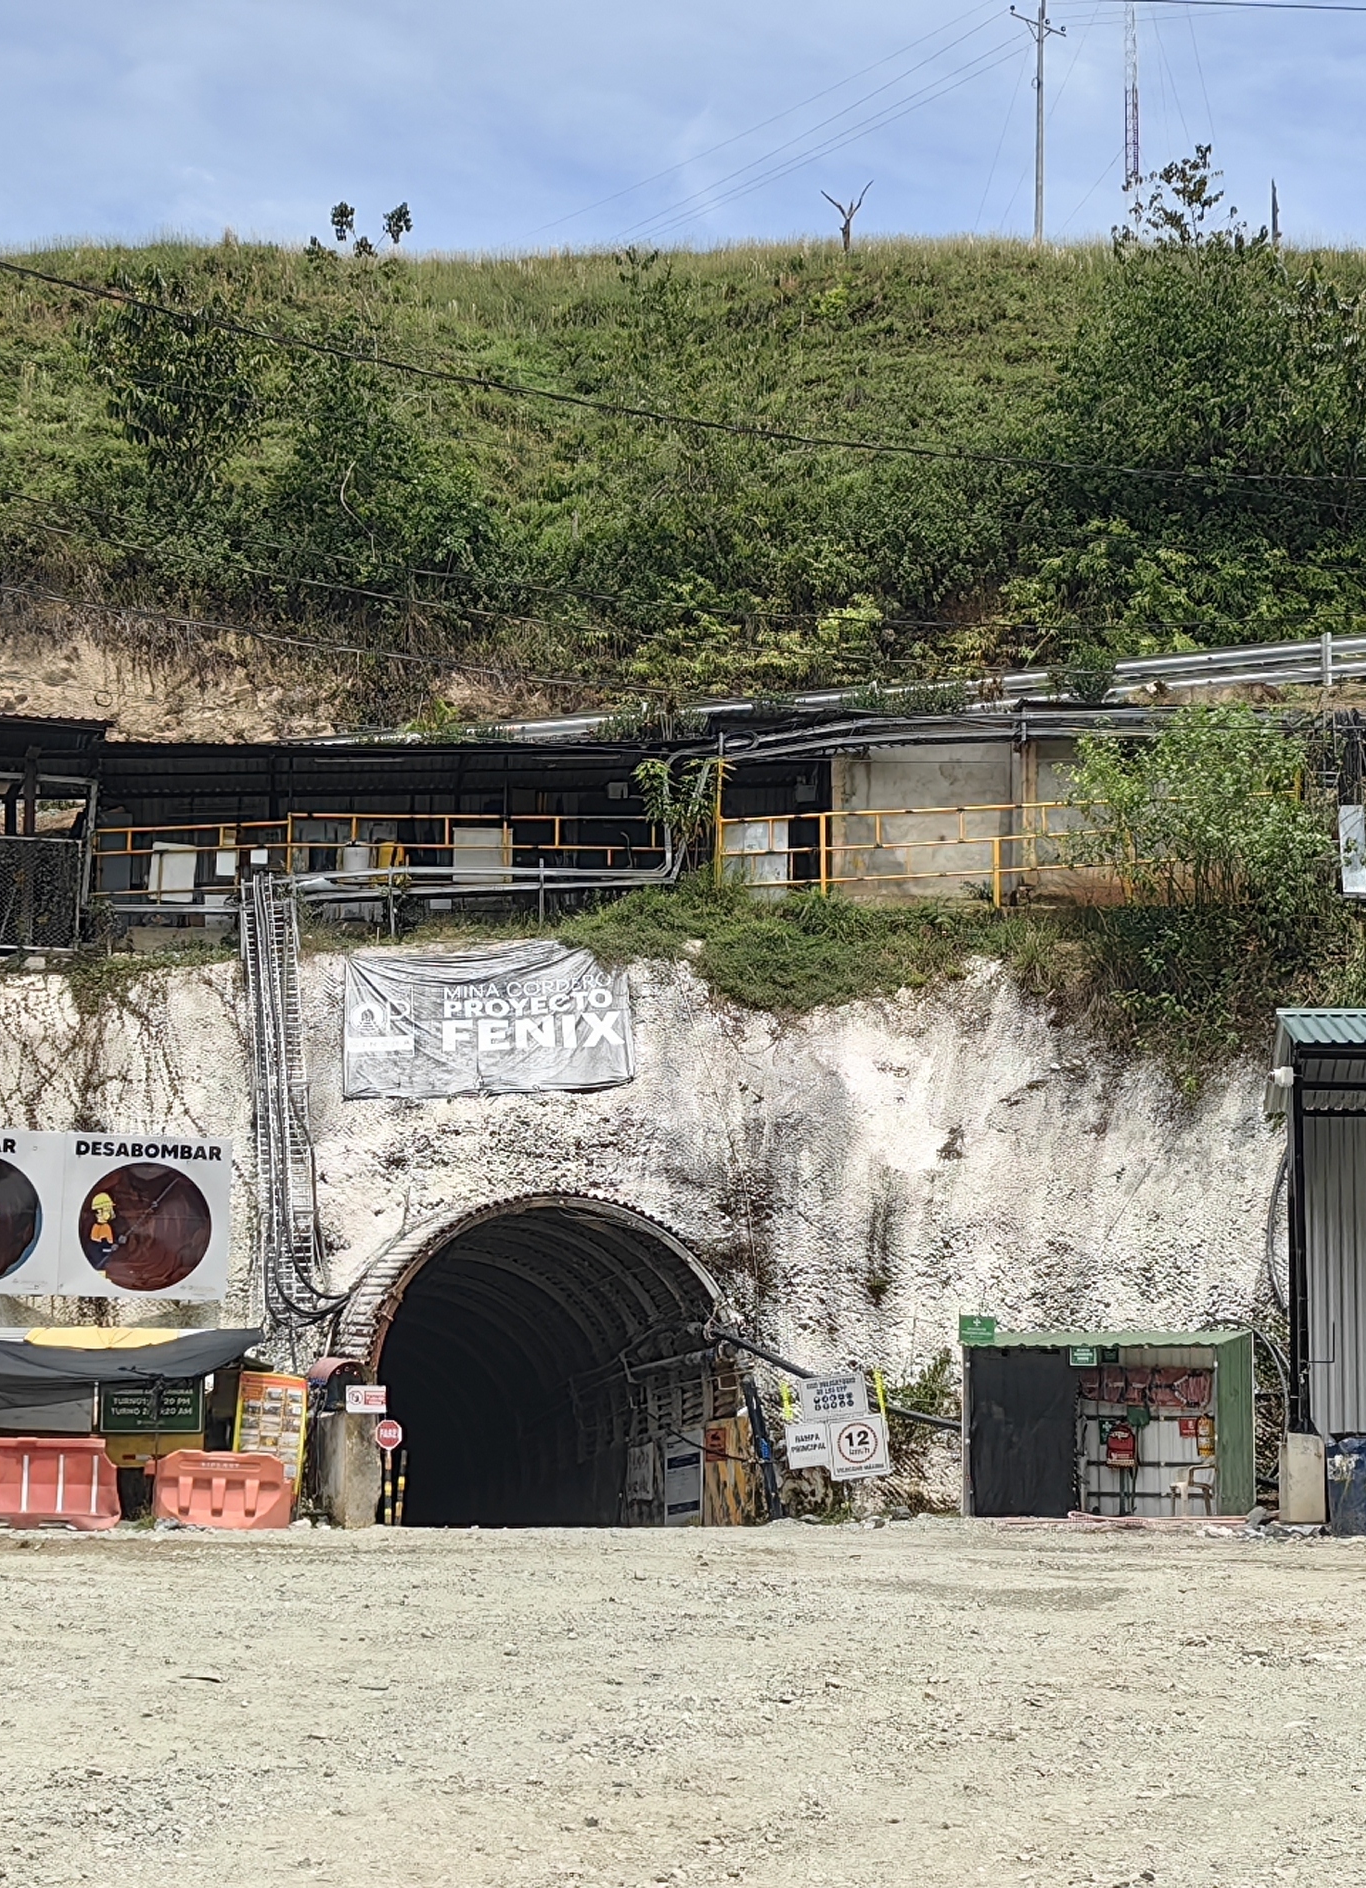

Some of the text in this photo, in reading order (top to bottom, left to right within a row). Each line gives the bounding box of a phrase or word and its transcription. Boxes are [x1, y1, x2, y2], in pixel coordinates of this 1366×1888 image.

[444, 972, 612, 999] MINA CORDERO
[444, 988, 613, 1018] PROYECTO
[442, 1011, 624, 1051] FENIX
[75, 1140, 222, 1161] DESABOMBAR
[791, 1442, 826, 1453] PRINCIPAL
[845, 1430, 869, 1446] 12
